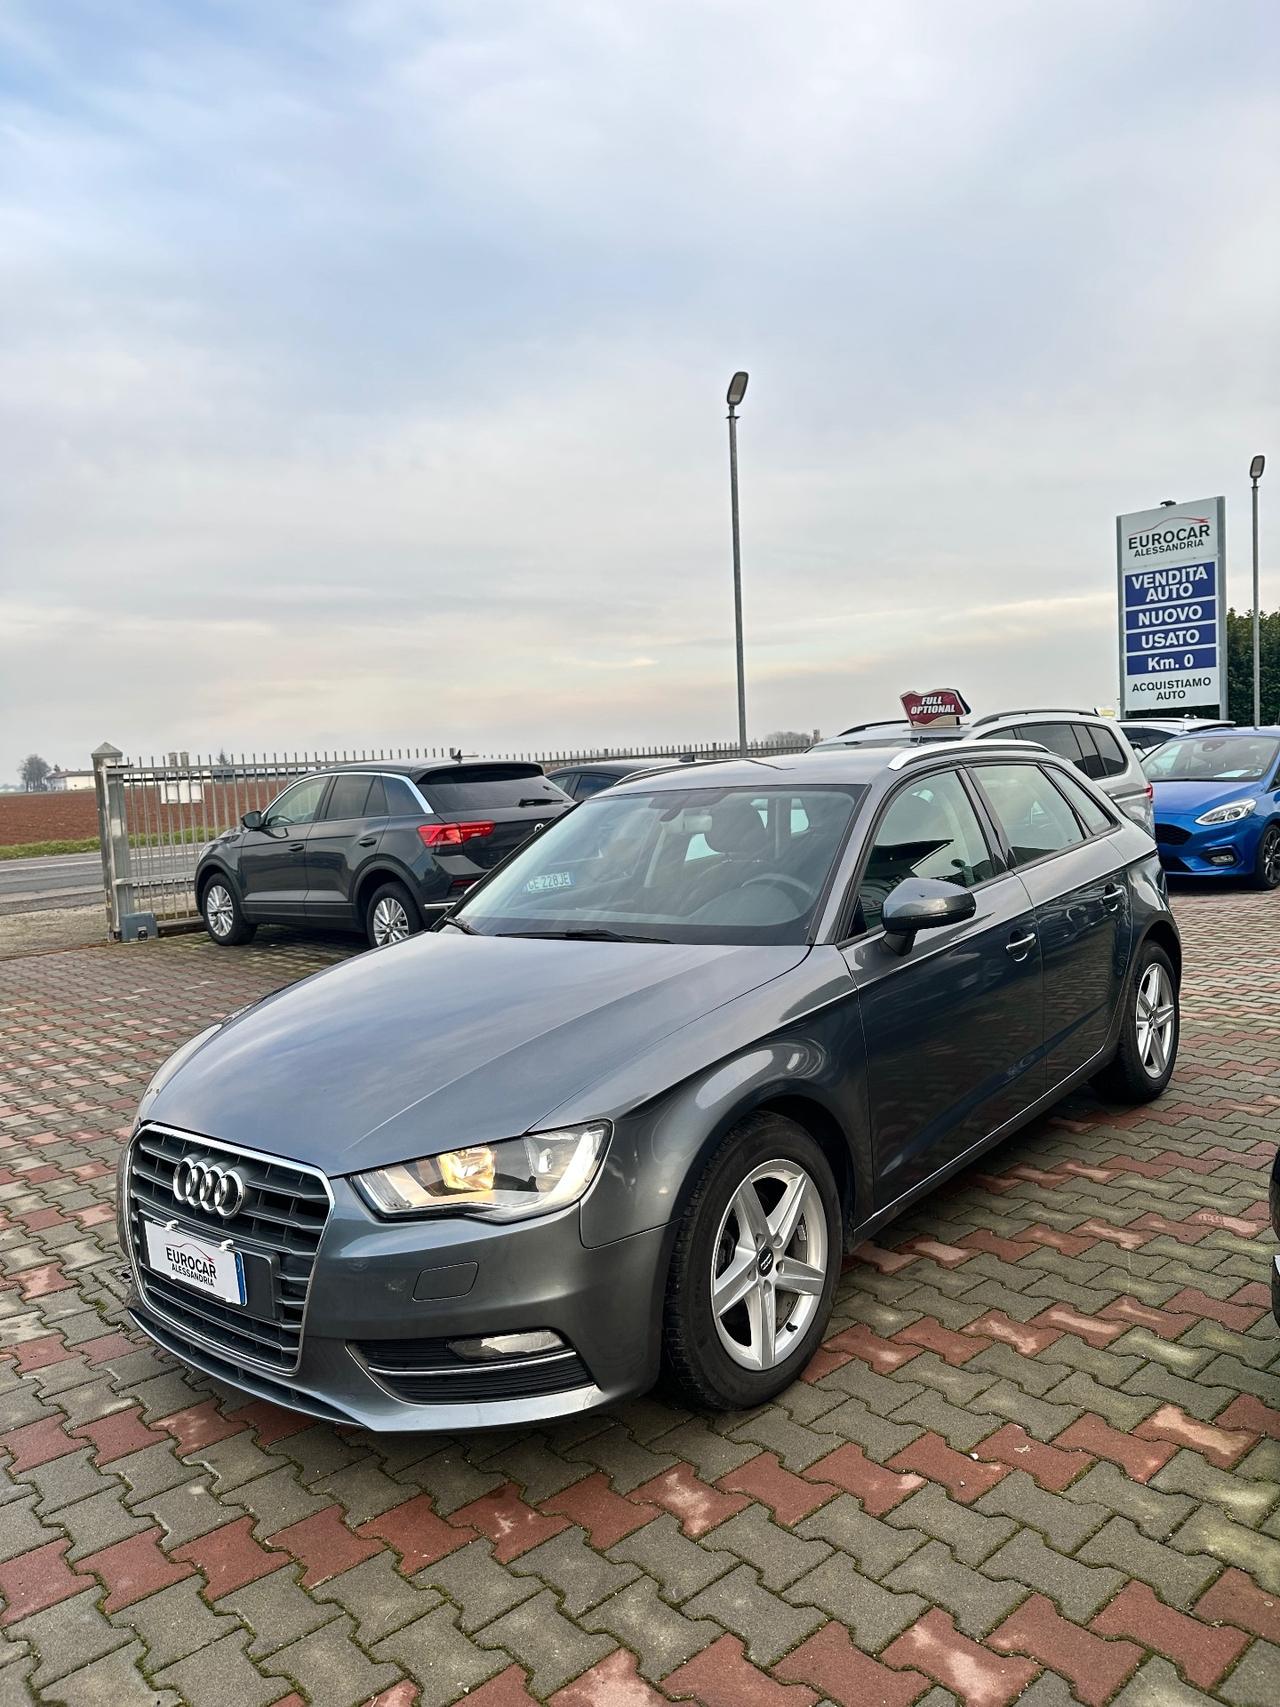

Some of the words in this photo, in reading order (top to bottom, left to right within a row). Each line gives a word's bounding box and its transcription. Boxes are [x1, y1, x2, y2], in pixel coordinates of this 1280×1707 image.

[1128, 524, 1210, 550] EUROCAR
[1134, 540, 1204, 558] ALESSANDRIA
[1132, 566, 1208, 590] VENDITA
[1146, 583, 1193, 603] AUTO
[1138, 605, 1203, 627] NUOVO
[1141, 629, 1200, 649] USATO
[1147, 655, 1180, 672] Km.
[1184, 653, 1194, 668] 0
[1132, 676, 1212, 693] ACQUISTIAMO
[921, 696, 942, 705] FULL
[1156, 689, 1186, 701] AUTO
[911, 705, 955, 714] OPTIONAL
[166, 1247, 218, 1279] EUROCAR
[171, 1264, 215, 1287] ALESSANDRIA
